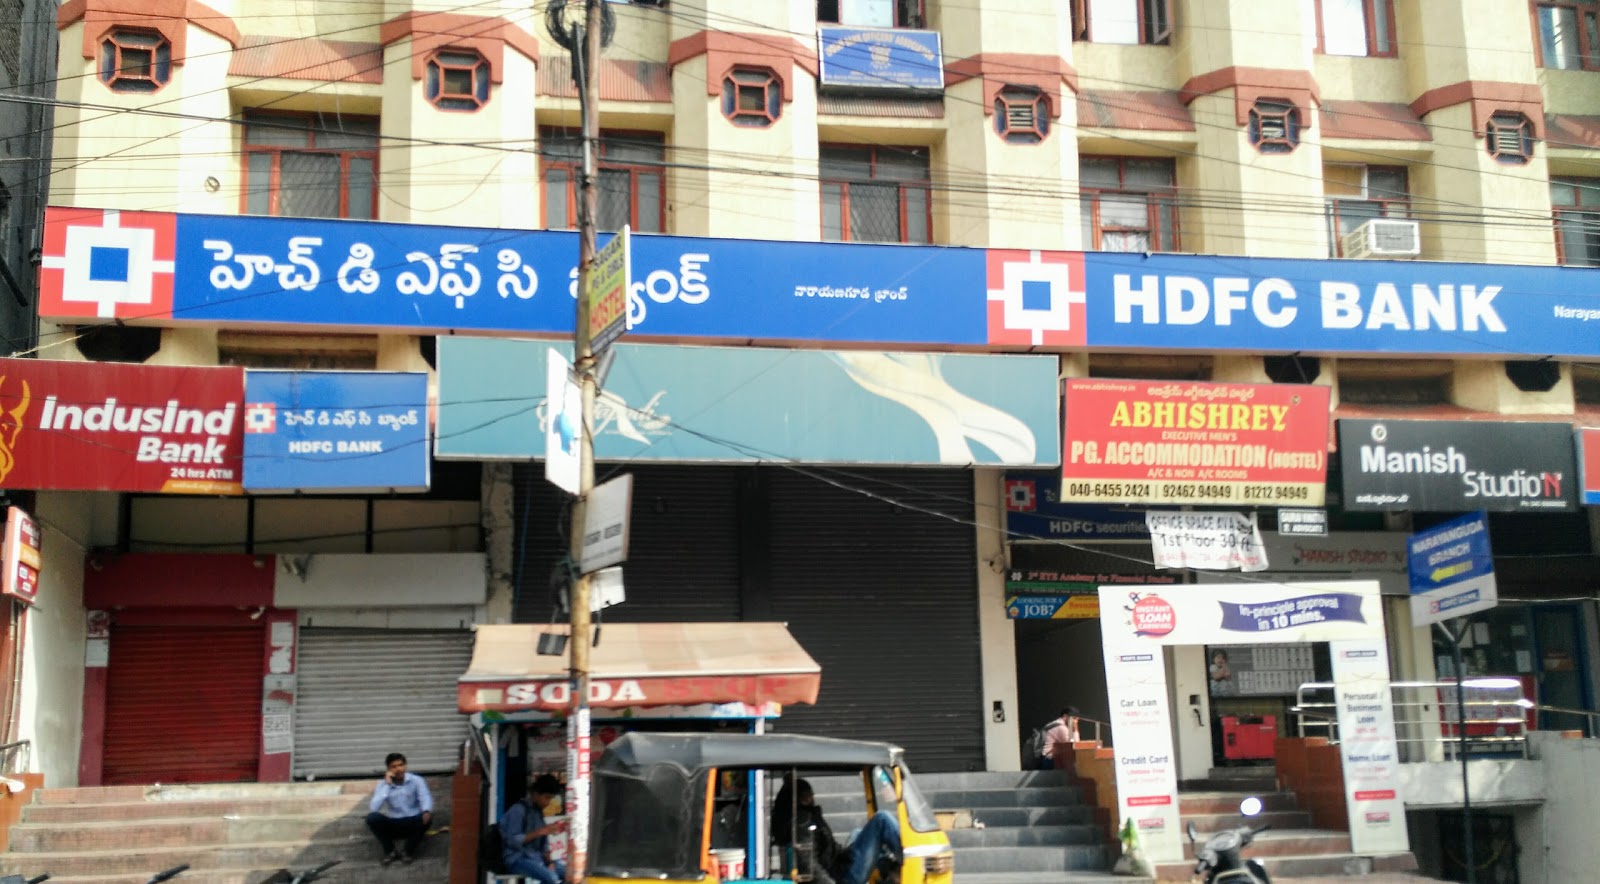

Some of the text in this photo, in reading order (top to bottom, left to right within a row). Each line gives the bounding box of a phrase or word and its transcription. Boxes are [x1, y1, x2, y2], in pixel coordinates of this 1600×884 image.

[337, 242, 380, 294] డి
[396, 243, 479, 309] ఎఫ్
[497, 249, 538, 300] సి
[590, 285, 626, 331] HOSTEL
[1113, 273, 1508, 333] HDFC BANK
[1554, 305, 1600, 321] Naraya
[1072, 382, 1136, 392] www.abhishrey.in
[39, 396, 237, 436] IndusInd
[1110, 400, 1289, 432] ABHISHREY
[1162, 430, 1237, 442] EXECUTIVE MEN'S
[136, 437, 227, 464] Bank
[288, 441, 383, 453] HDFC BANK
[1071, 441, 1323, 470] PG. ACCOMMODATION (HOSTEL)
[1360, 445, 1466, 474] Manish
[170, 467, 234, 480] 24 hrs ATM
[1147, 468, 1164, 478] A/C
[1174, 468, 1194, 479] NON
[1198, 468, 1214, 479] A/C
[1215, 469, 1248, 480] ROOMS
[1070, 483, 1122, 497] 040-6455
[1125, 484, 1149, 497] 2424
[1163, 484, 1196, 498] 92462
[1199, 485, 1231, 498] 94949
[1244, 485, 1274, 499] 81212
[1276, 486, 1308, 499] 94949
[1050, 521, 1093, 533] HDFC
[1023, 604, 1055, 618] JOB?
[1296, 598, 1338, 611] approval
[1139, 613, 1172, 623] LOAN
[1271, 615, 1288, 629] 10
[506, 680, 647, 705] SODA
[1120, 699, 1157, 708] Car Loan
[1121, 755, 1168, 765] Credit Card
